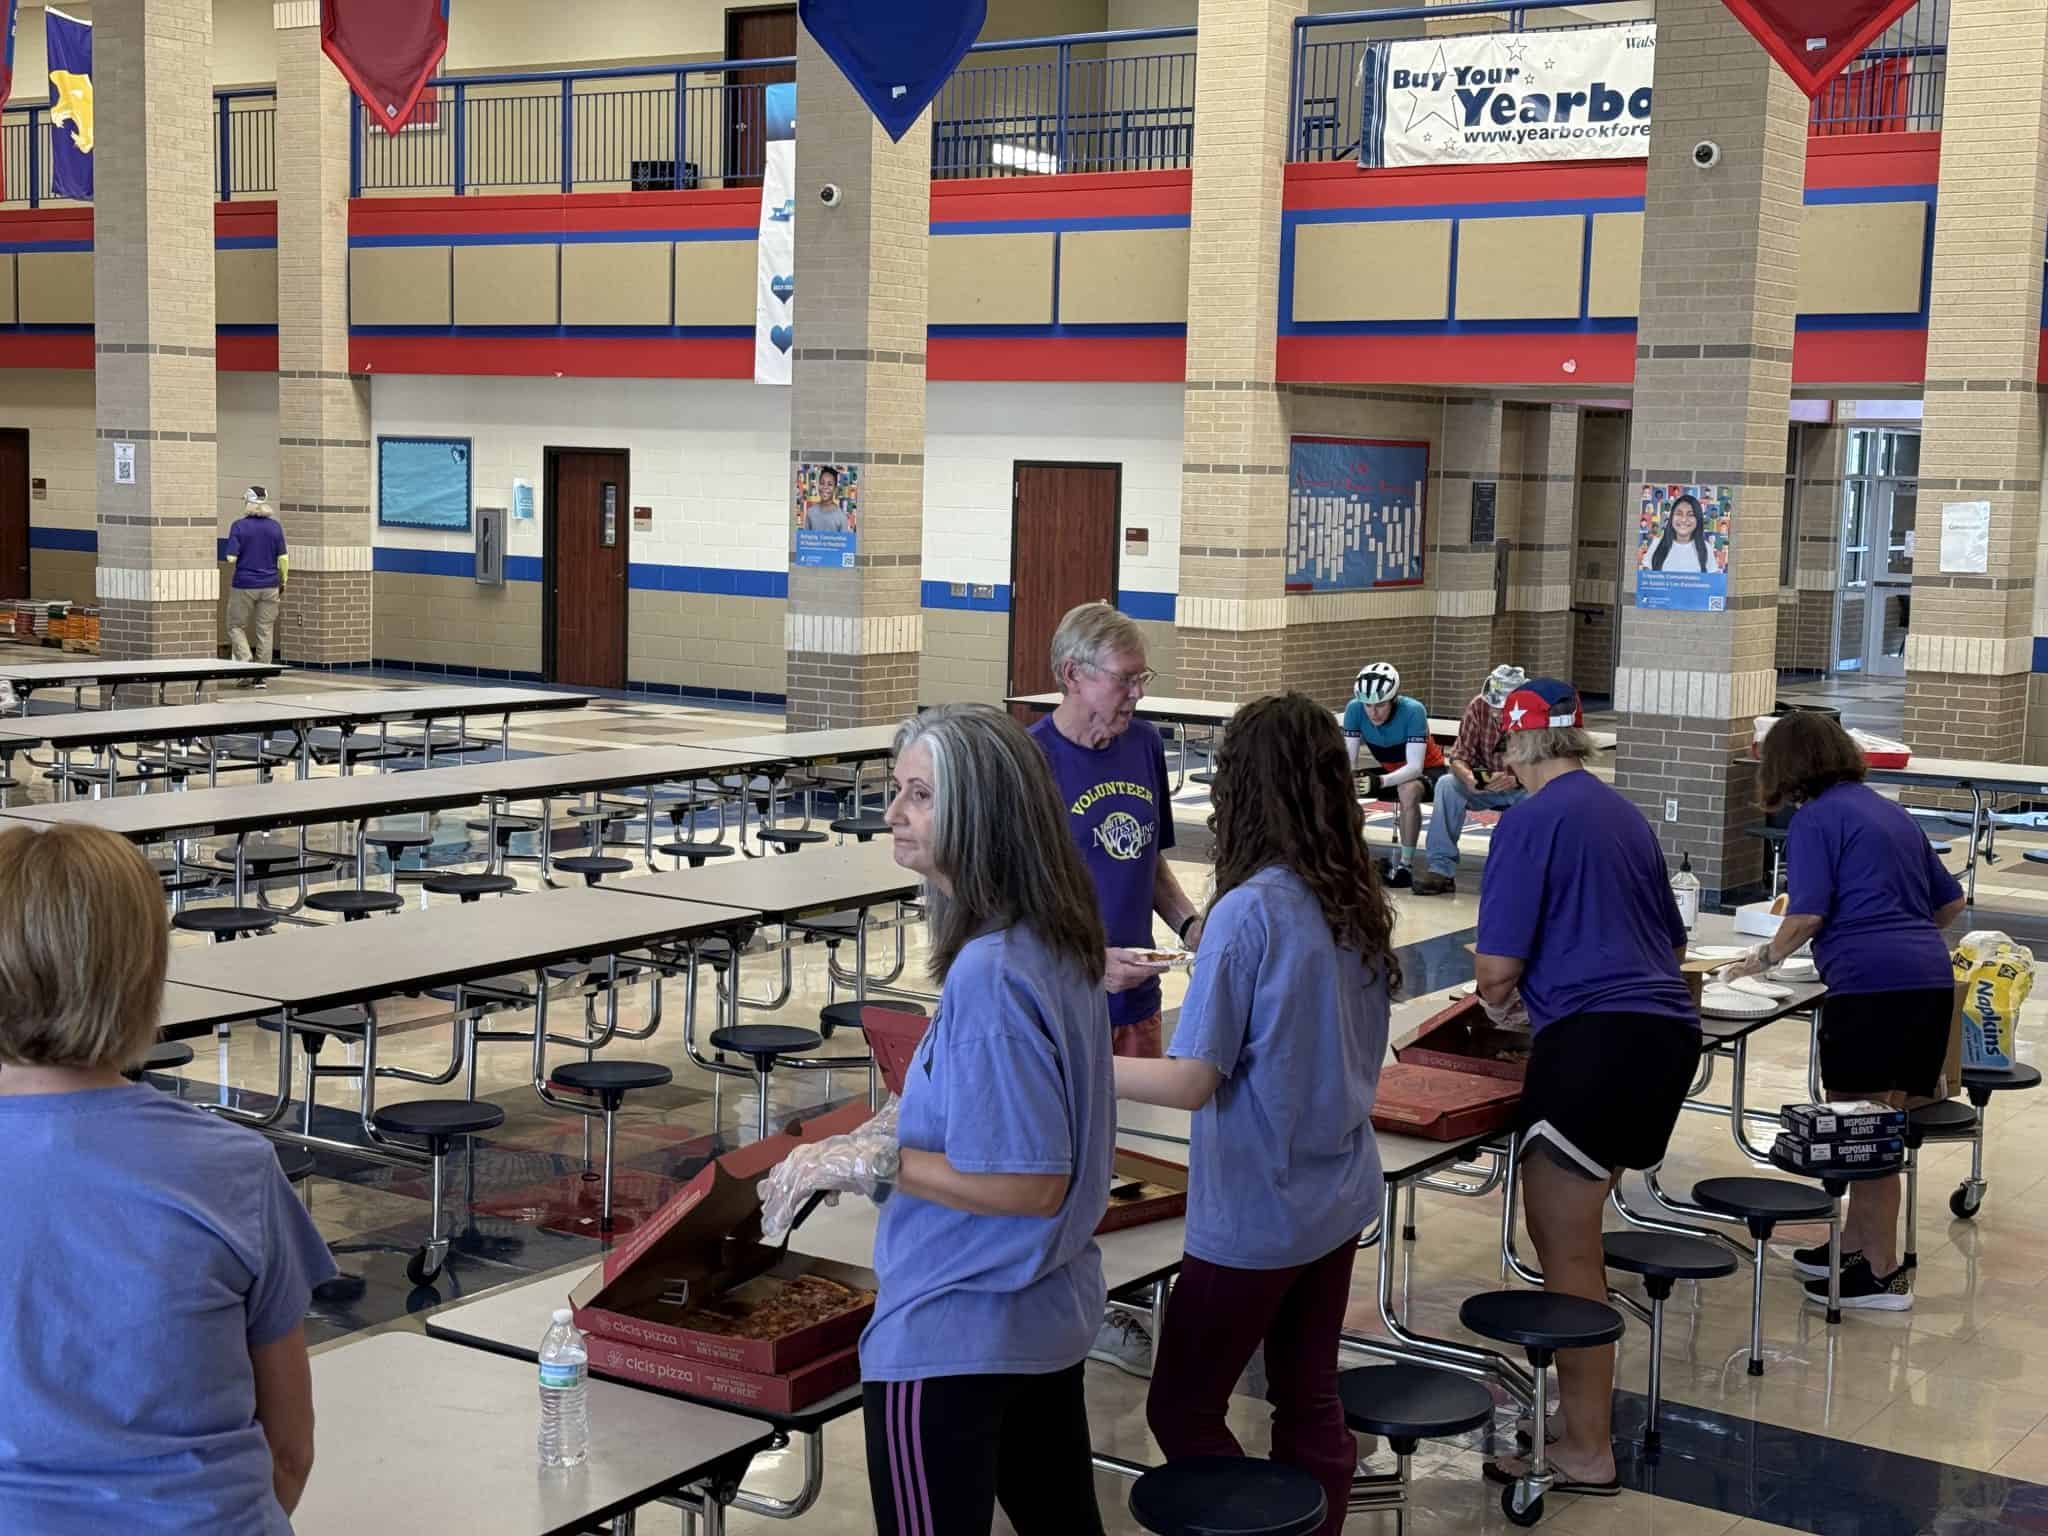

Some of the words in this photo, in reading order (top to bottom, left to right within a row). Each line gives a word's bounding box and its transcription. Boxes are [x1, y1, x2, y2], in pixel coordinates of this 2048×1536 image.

[1392, 69, 1447, 91] Buy
[1454, 65, 1520, 86] Your
[1454, 82, 1653, 127] Yearbo
[1071, 781, 1153, 815] VOLUNTEER
[1974, 980, 2003, 1056] Napkins
[1843, 1115, 1881, 1128] DISPOSABLE
[1850, 1126, 1875, 1136] GLOVES
[1838, 1143, 1878, 1155] DISPOSABLE
[1846, 1153, 1871, 1163] GLOVES
[643, 1326, 677, 1345] pizza
[657, 1363, 693, 1382] pizza
